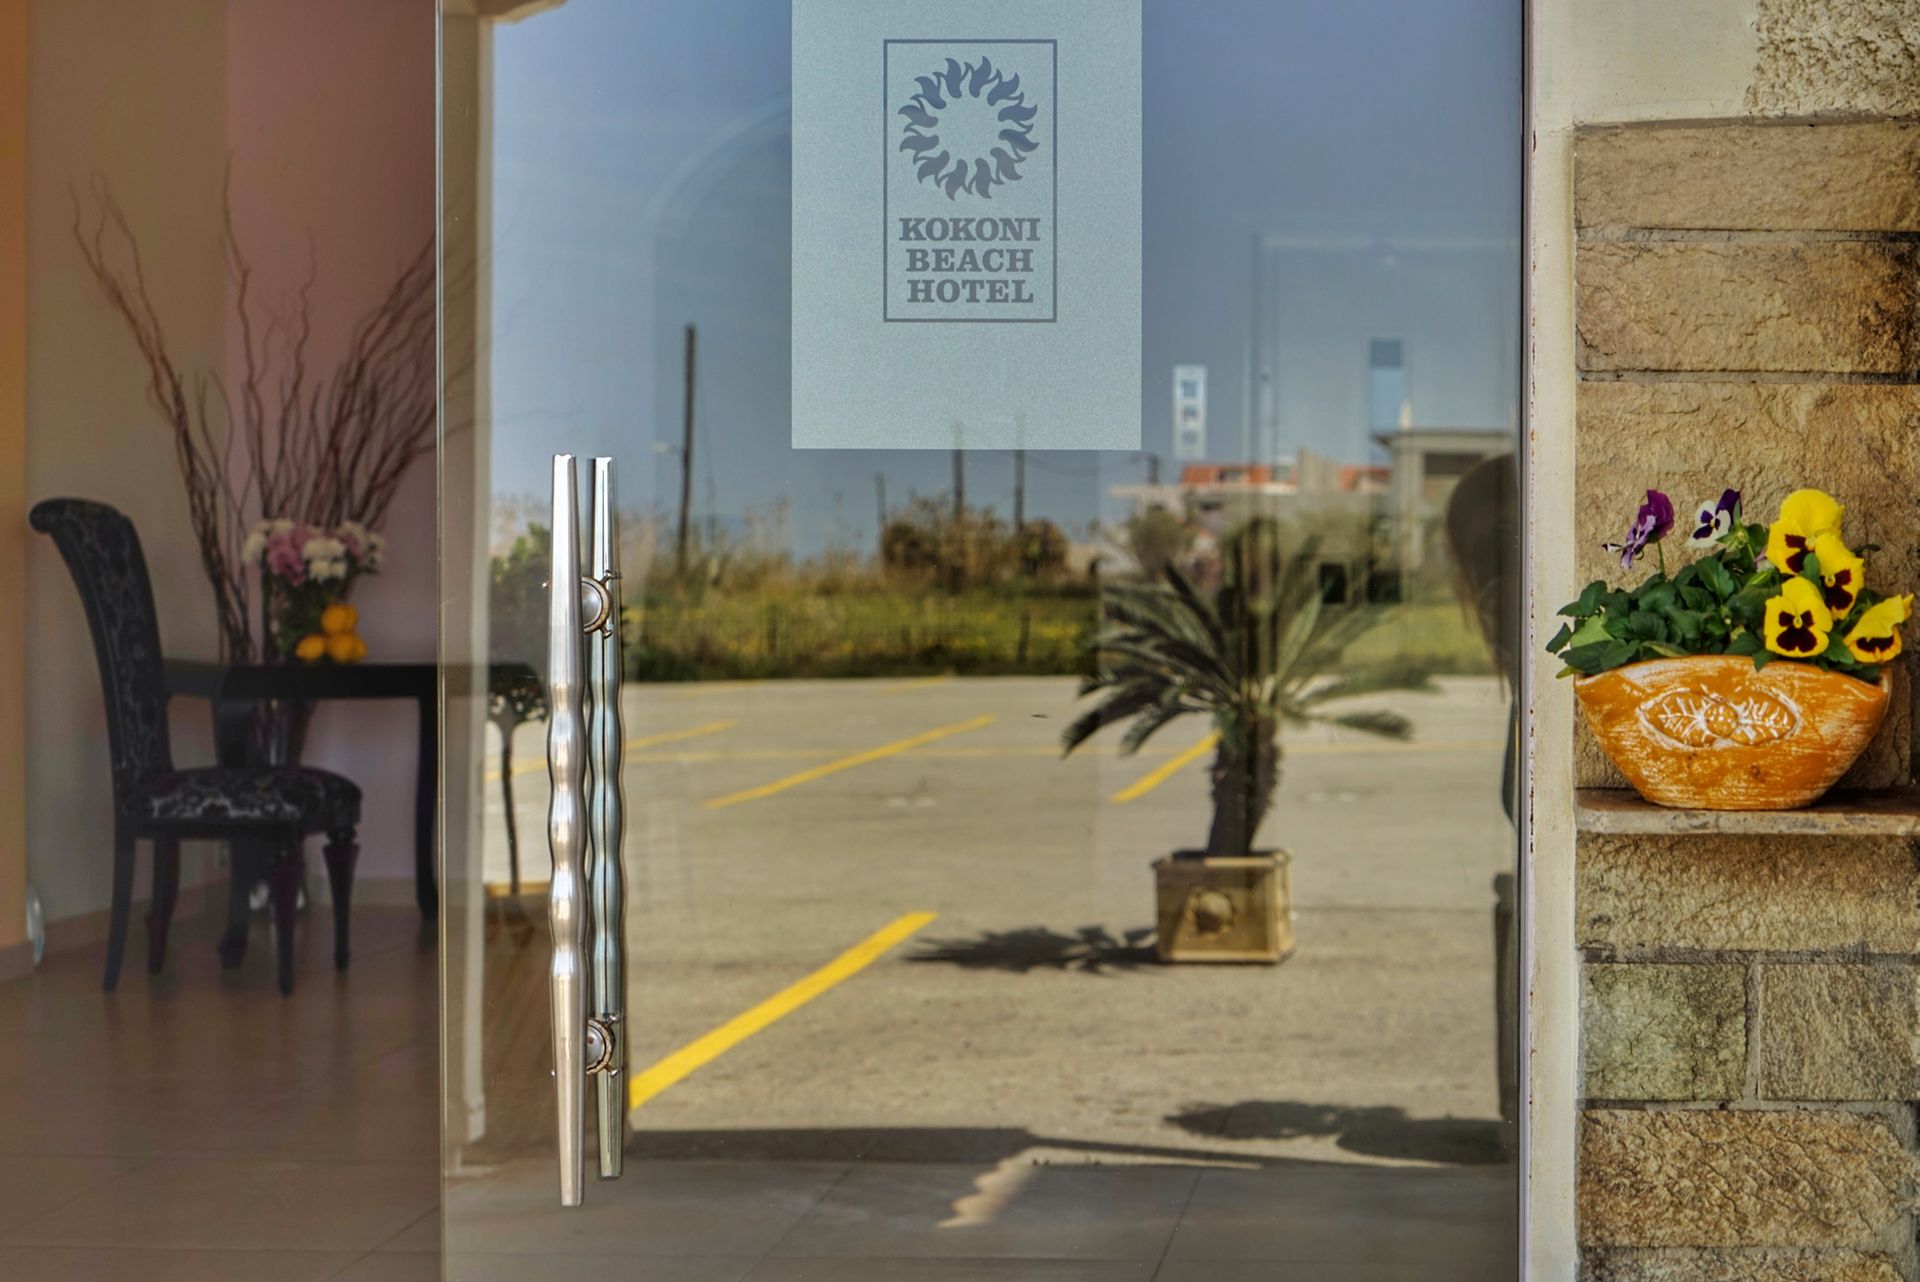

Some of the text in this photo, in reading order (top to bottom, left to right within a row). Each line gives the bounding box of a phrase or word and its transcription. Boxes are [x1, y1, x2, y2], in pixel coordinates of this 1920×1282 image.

[899, 217, 1041, 242] KOKONI
[905, 248, 1034, 273] BEACH
[906, 279, 1034, 304] HOTEL
